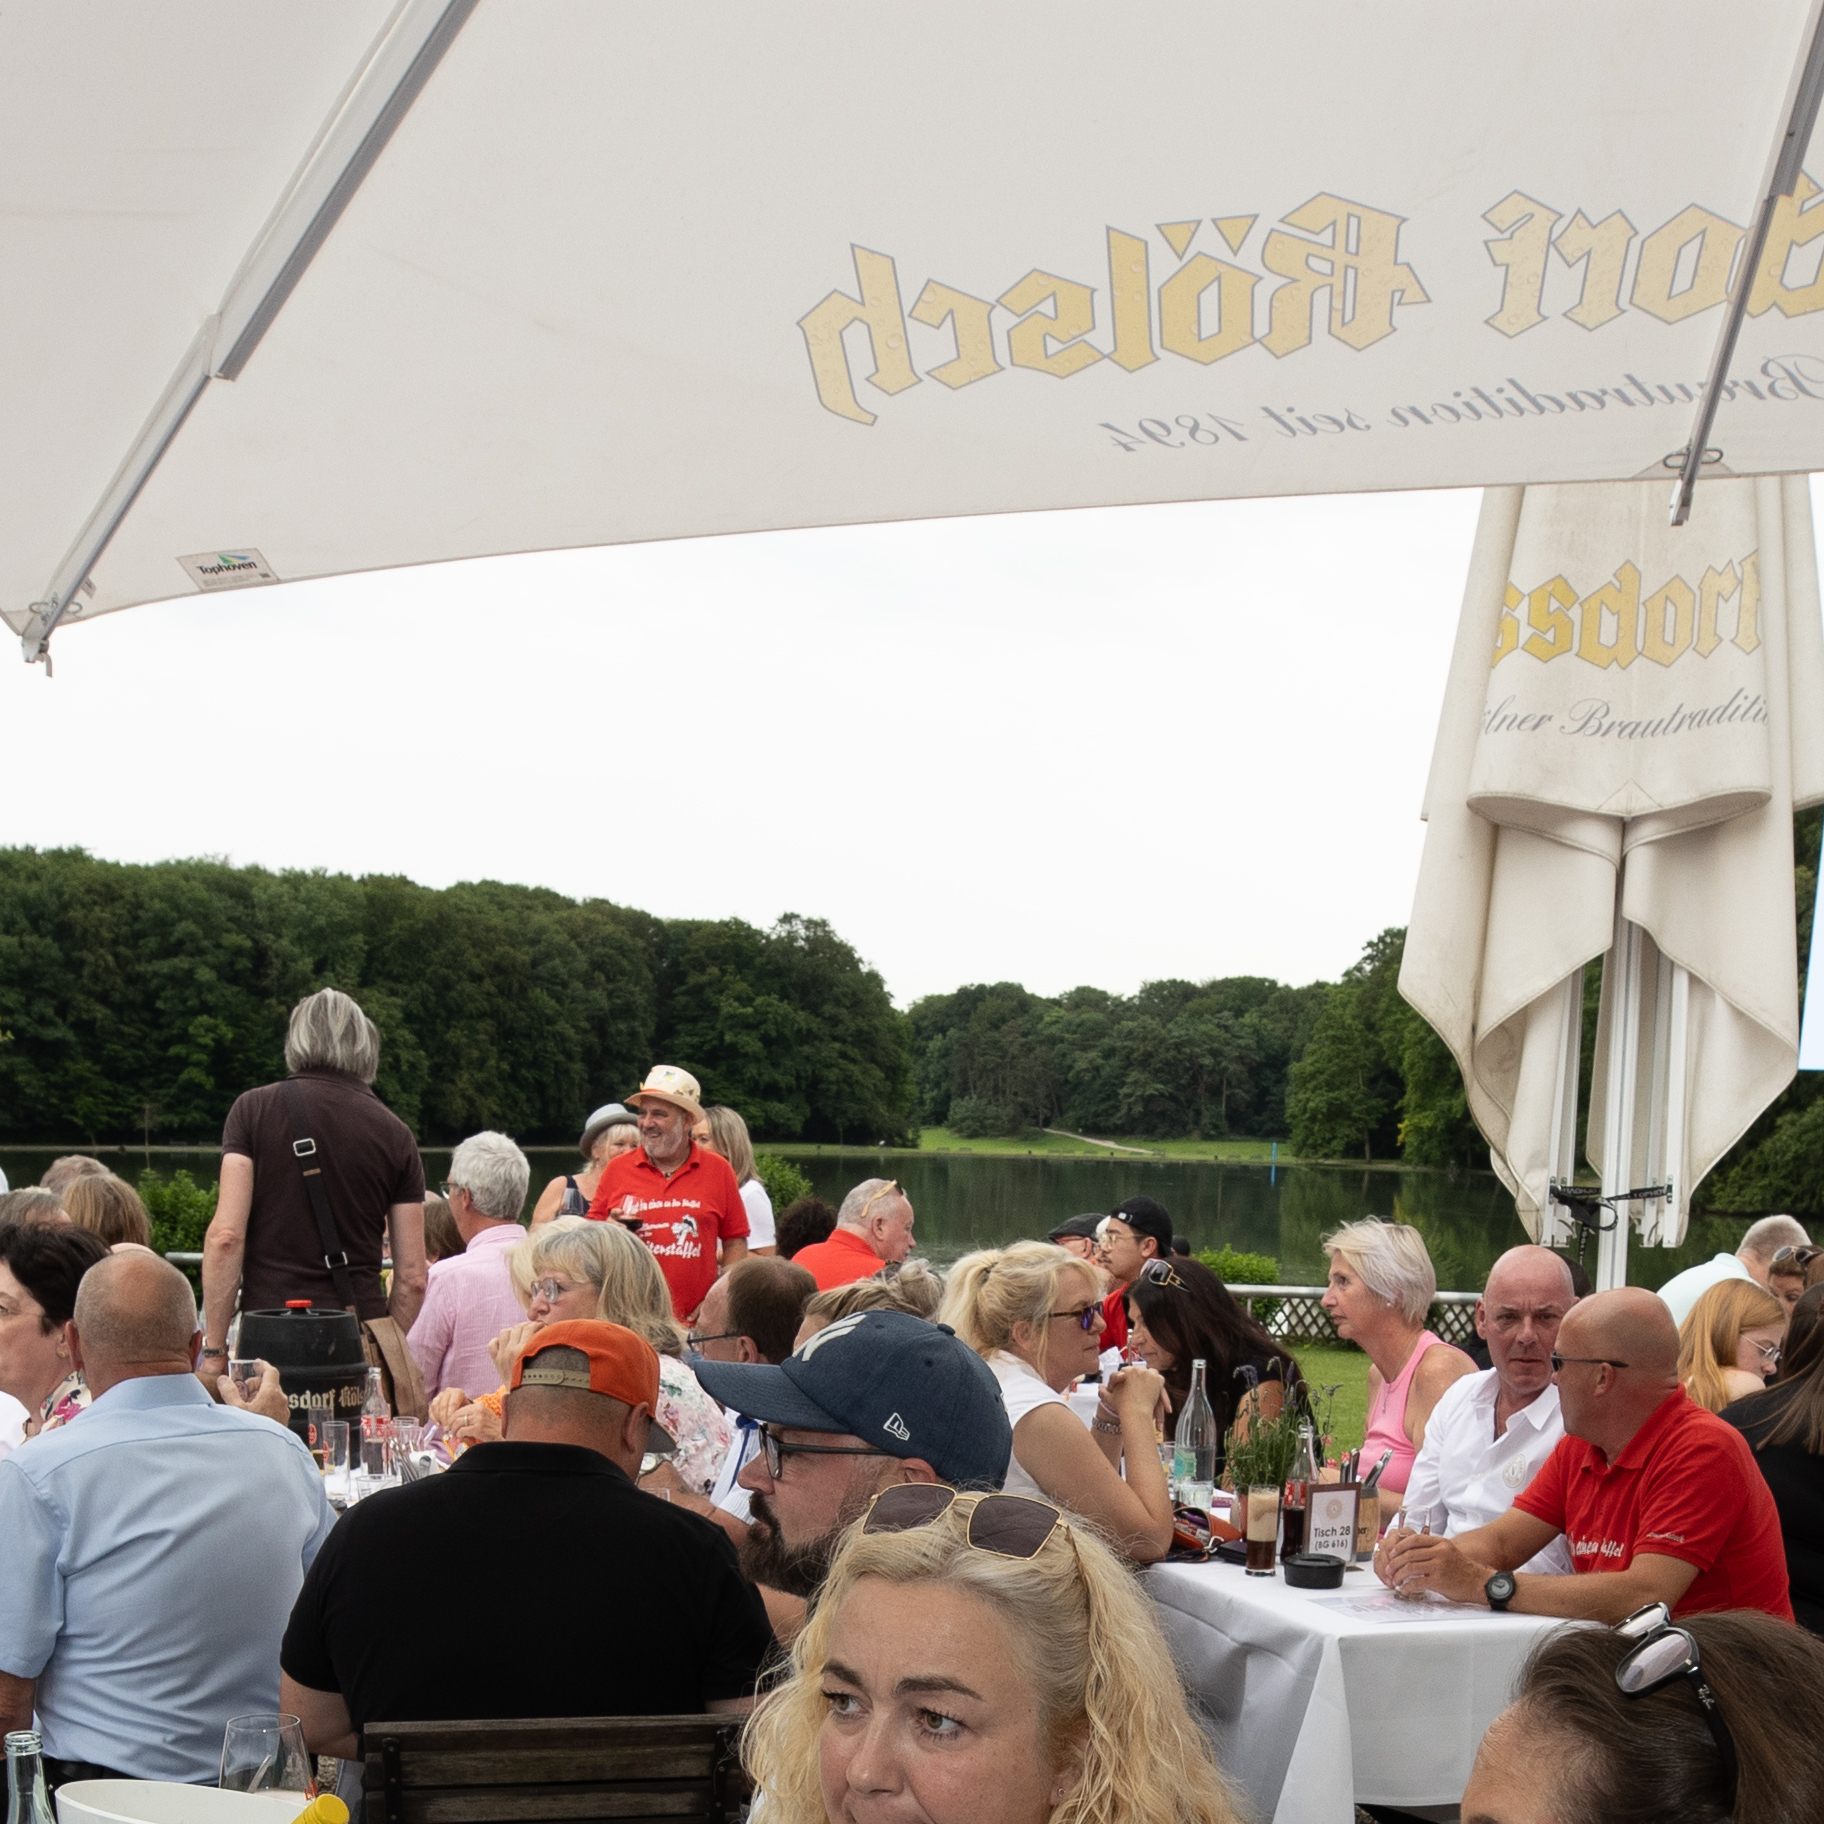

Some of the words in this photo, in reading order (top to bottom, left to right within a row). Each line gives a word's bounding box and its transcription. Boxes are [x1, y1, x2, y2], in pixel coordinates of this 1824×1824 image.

[196, 560, 258, 576] Tophoven
[1491, 548, 1763, 670] ssdorf
[1559, 686, 1768, 740] Brautraditi
[288, 1389, 336, 1410] sdorf
[1313, 1526, 1337, 1539] Tisch
[1339, 1525, 1351, 1537] 28
